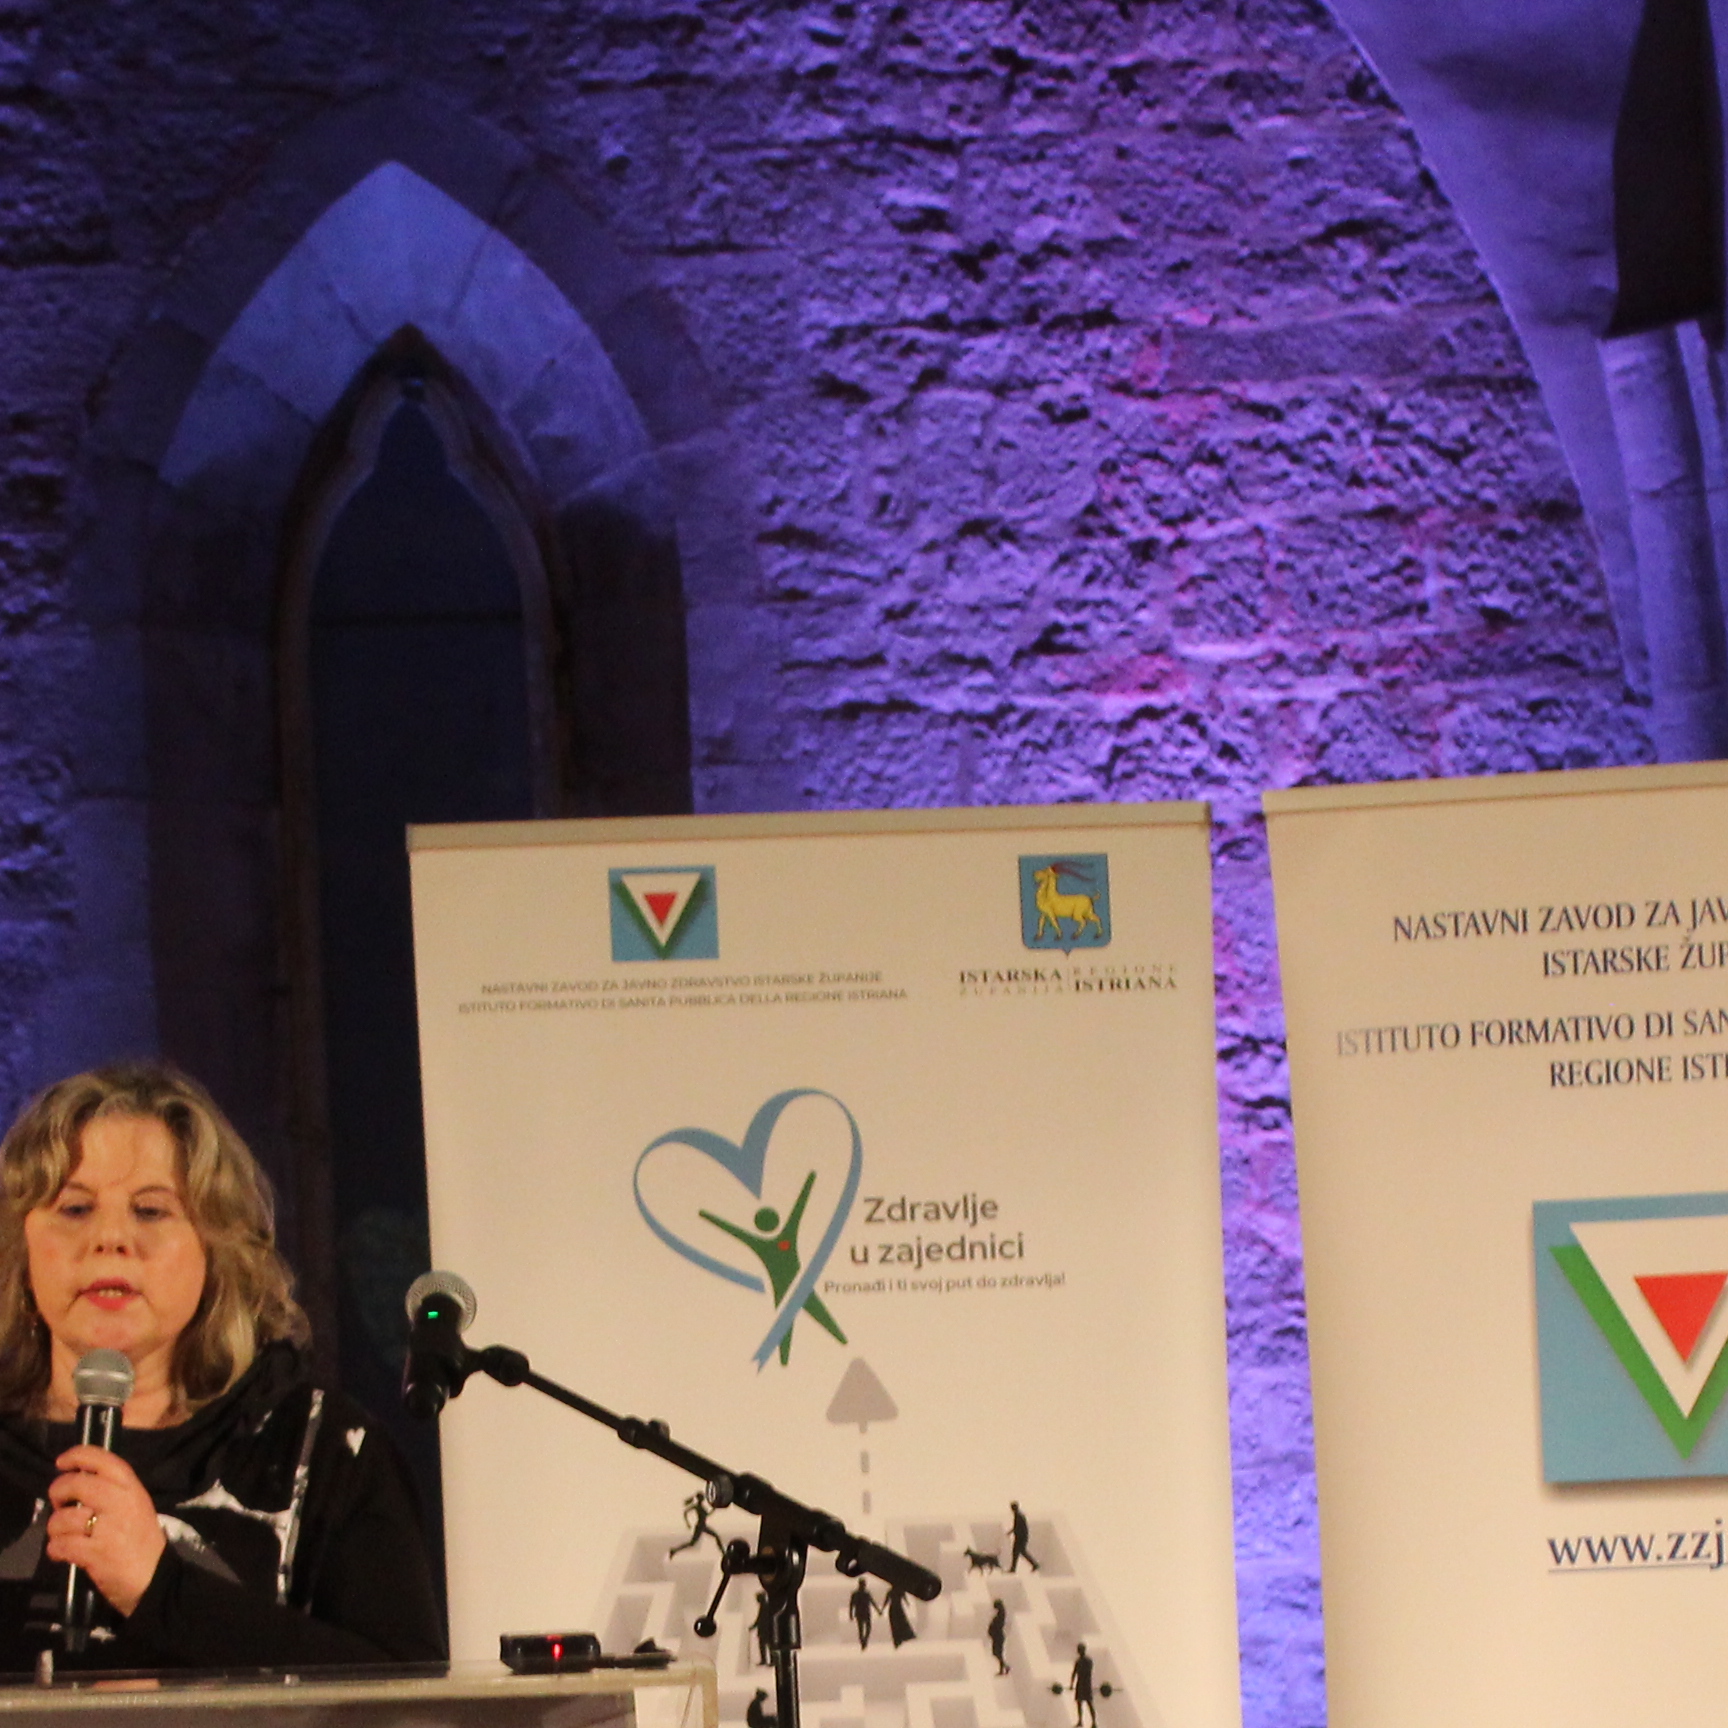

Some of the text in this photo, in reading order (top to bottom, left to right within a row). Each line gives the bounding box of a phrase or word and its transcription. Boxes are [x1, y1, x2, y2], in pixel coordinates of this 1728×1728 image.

[1392, 908, 1529, 941] NASTAVNI
[1538, 901, 1636, 933] ZAVOD
[1645, 898, 1681, 928] ZA
[959, 968, 1062, 984] ISTARSKA
[1542, 945, 1670, 978] ISTARSKE
[1074, 975, 1178, 992] ISTRIANA
[1336, 1022, 1461, 1056] ISTITUTO
[1470, 1012, 1635, 1048] FORMATIVO
[1644, 1010, 1674, 1038] DI
[1549, 1056, 1672, 1089] REGIONE
[864, 1193, 999, 1227] Zdravlje
[849, 1231, 1024, 1269] u zajednici
[911, 1276, 943, 1293] svoj
[946, 1276, 973, 1292] put
[976, 1275, 997, 1287] do
[1000, 1271, 1066, 1288] zdravlja!
